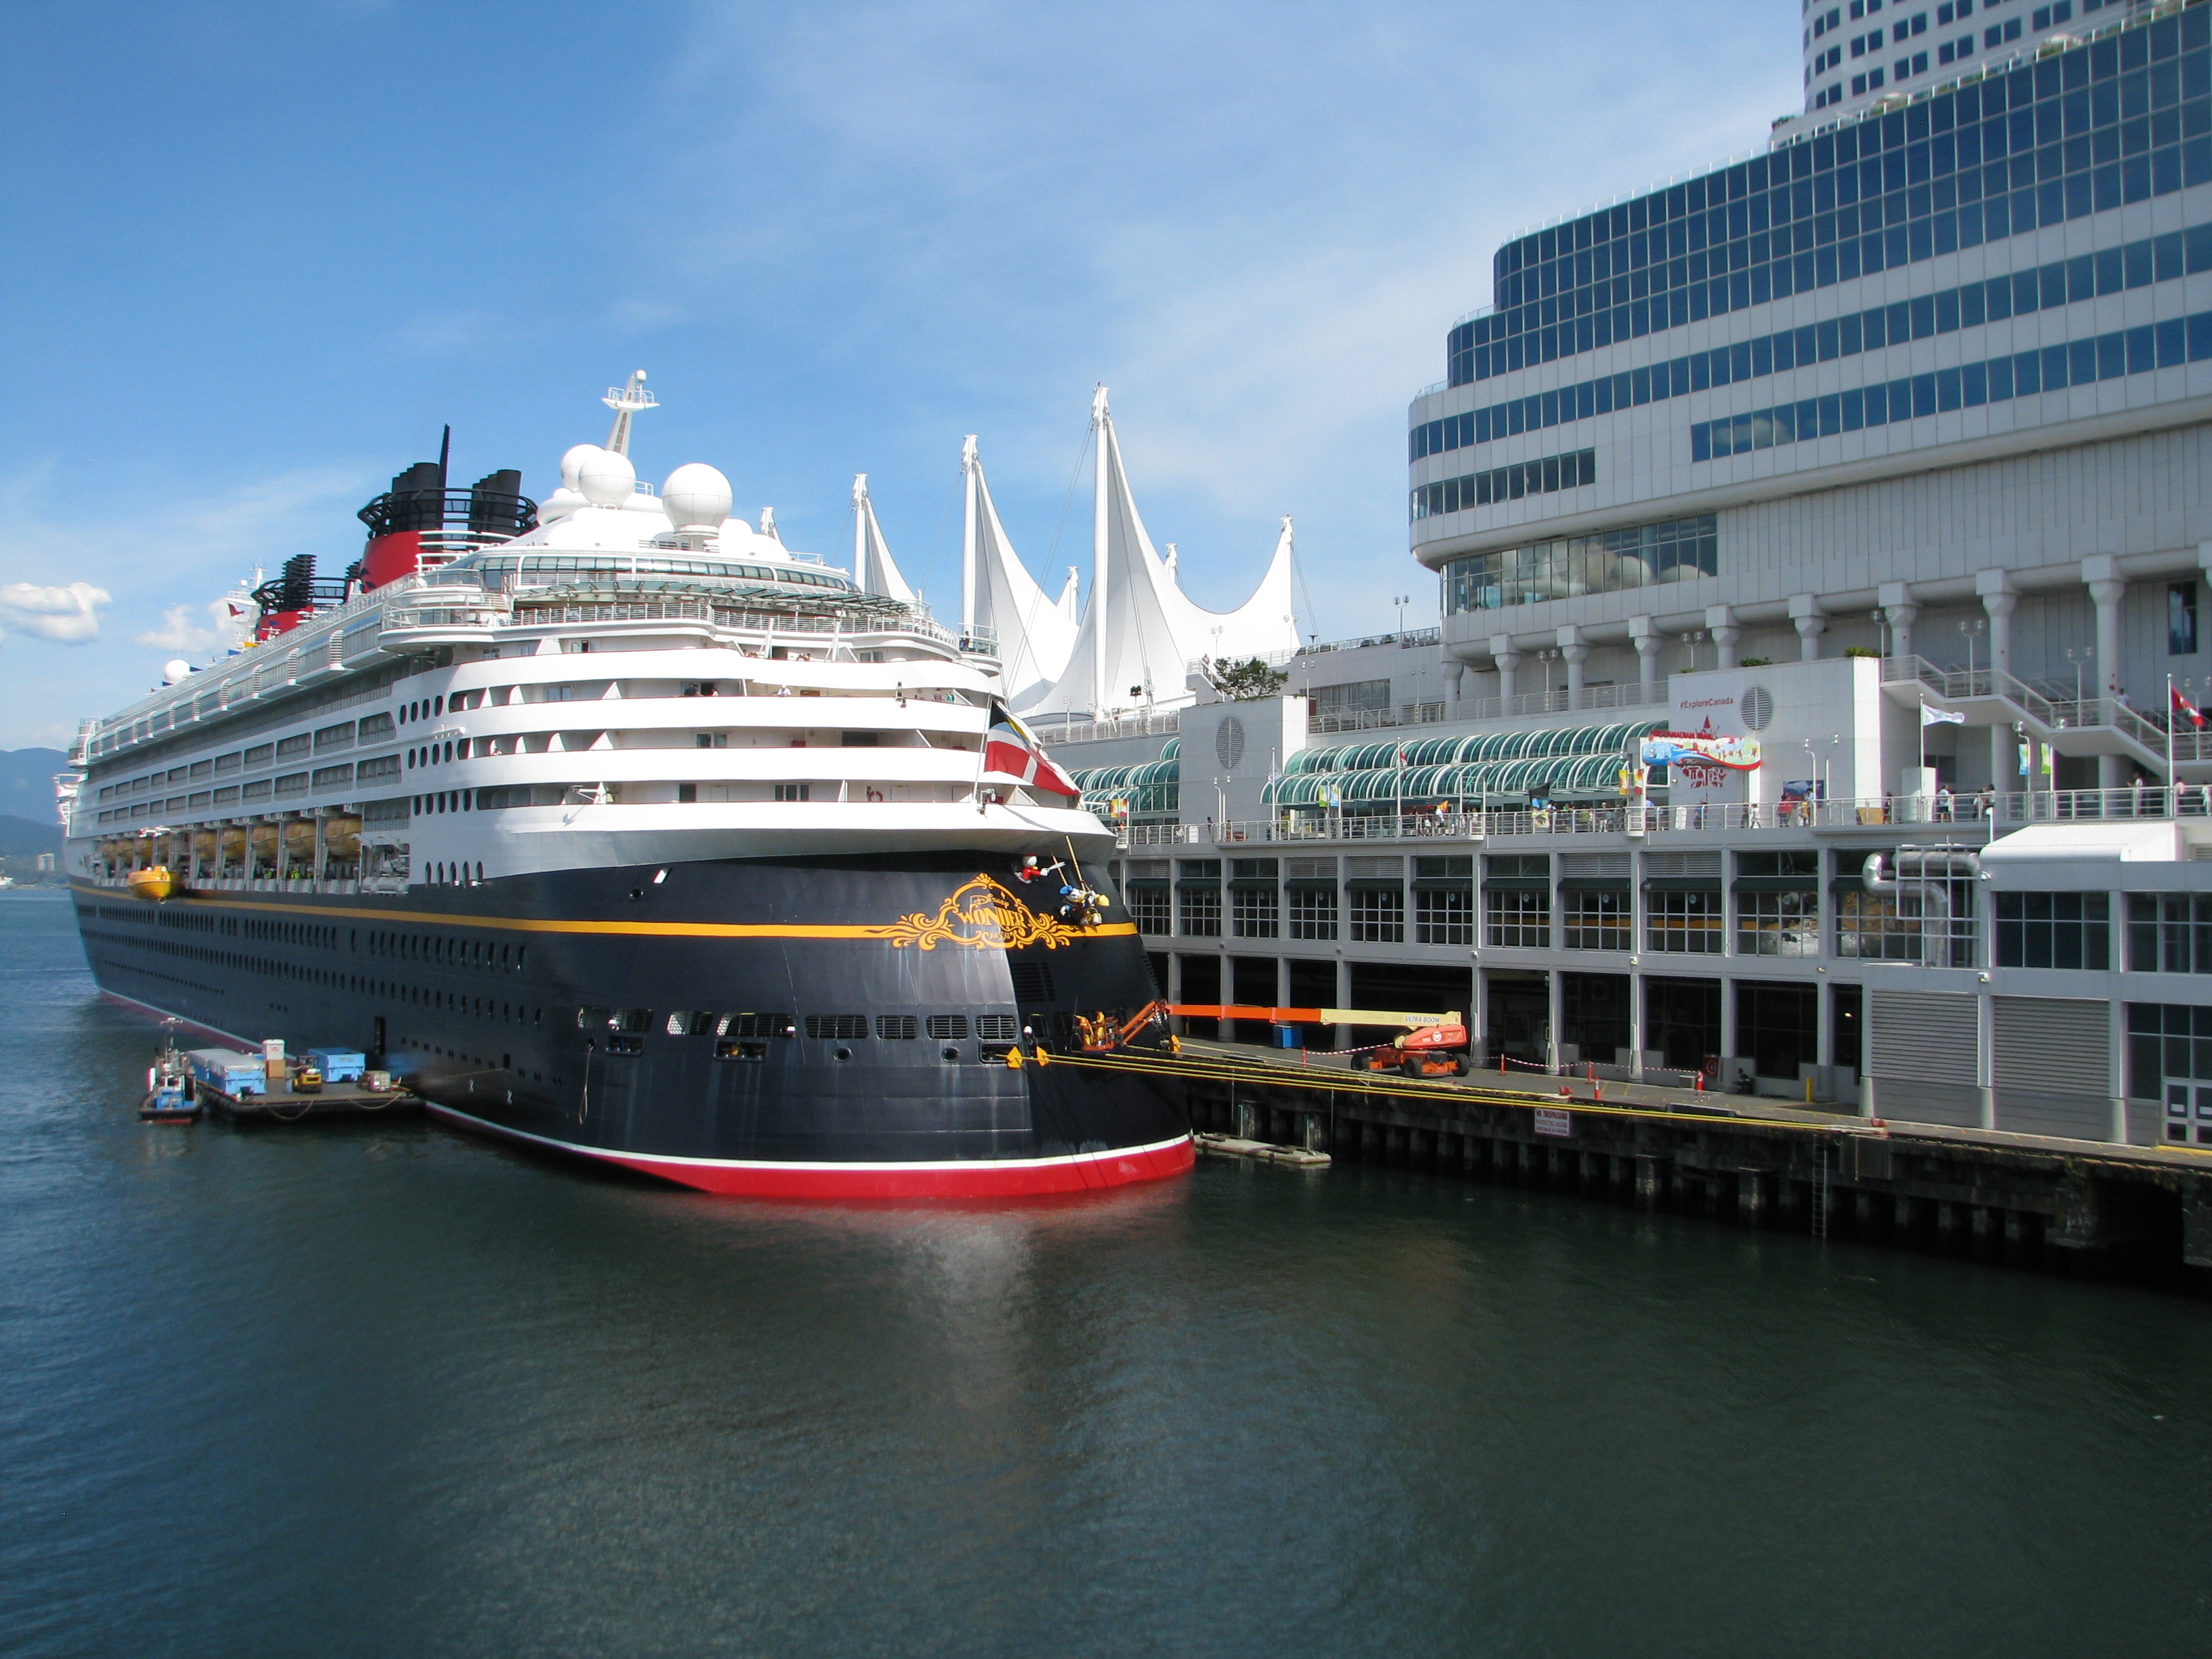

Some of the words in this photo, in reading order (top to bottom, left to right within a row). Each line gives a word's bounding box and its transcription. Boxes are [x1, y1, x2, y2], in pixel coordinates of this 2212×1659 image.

[1680, 697, 1734, 709] #ExploreCanada
[969, 893, 1010, 909] Disney
[956, 905, 1027, 931] WONDER
